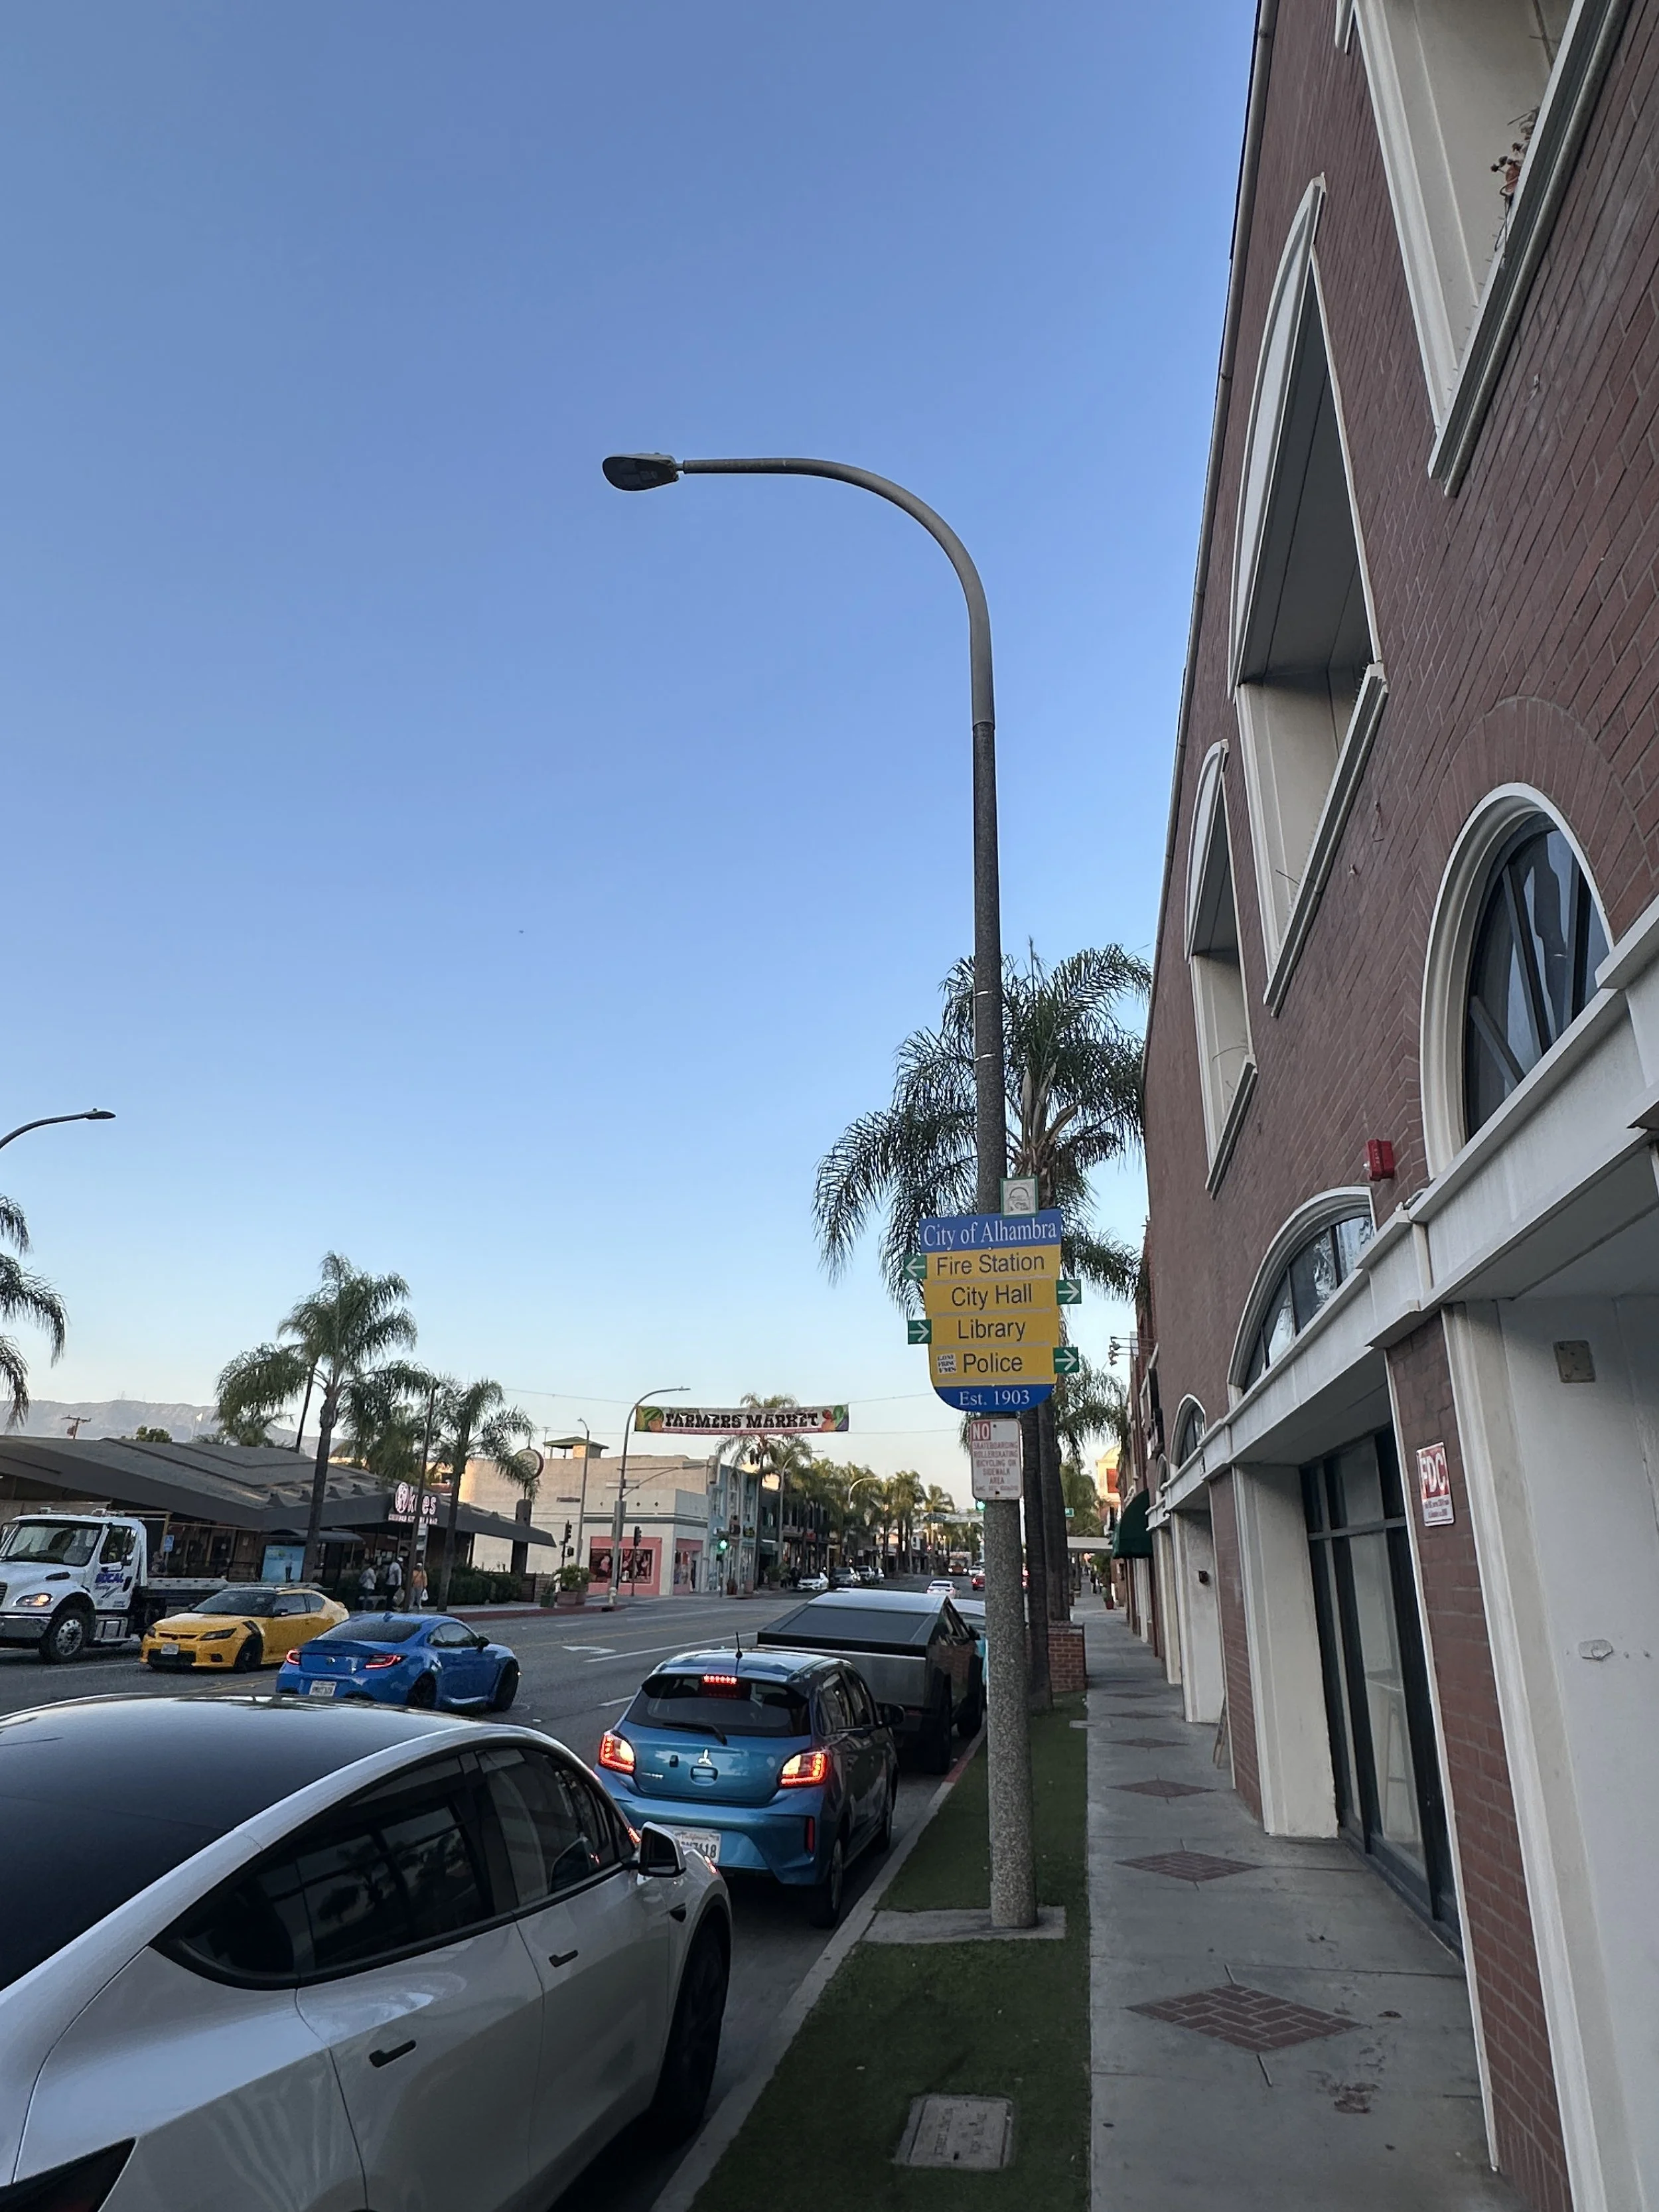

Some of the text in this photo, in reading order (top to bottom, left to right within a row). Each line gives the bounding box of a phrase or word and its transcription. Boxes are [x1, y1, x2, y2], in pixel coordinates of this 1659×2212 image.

[924, 1218, 1057, 1250] City of Alhambra
[937, 1252, 1045, 1276] Fire Station
[952, 1284, 1033, 1311] City Hall
[958, 1319, 1026, 1342] Library
[964, 1353, 1023, 1374] Police
[959, 1389, 1030, 1406] Est. 1903
[746, 1412, 819, 1428] MARKET
[972, 1423, 990, 1439] NO
[1420, 1452, 1445, 1493] FDC
